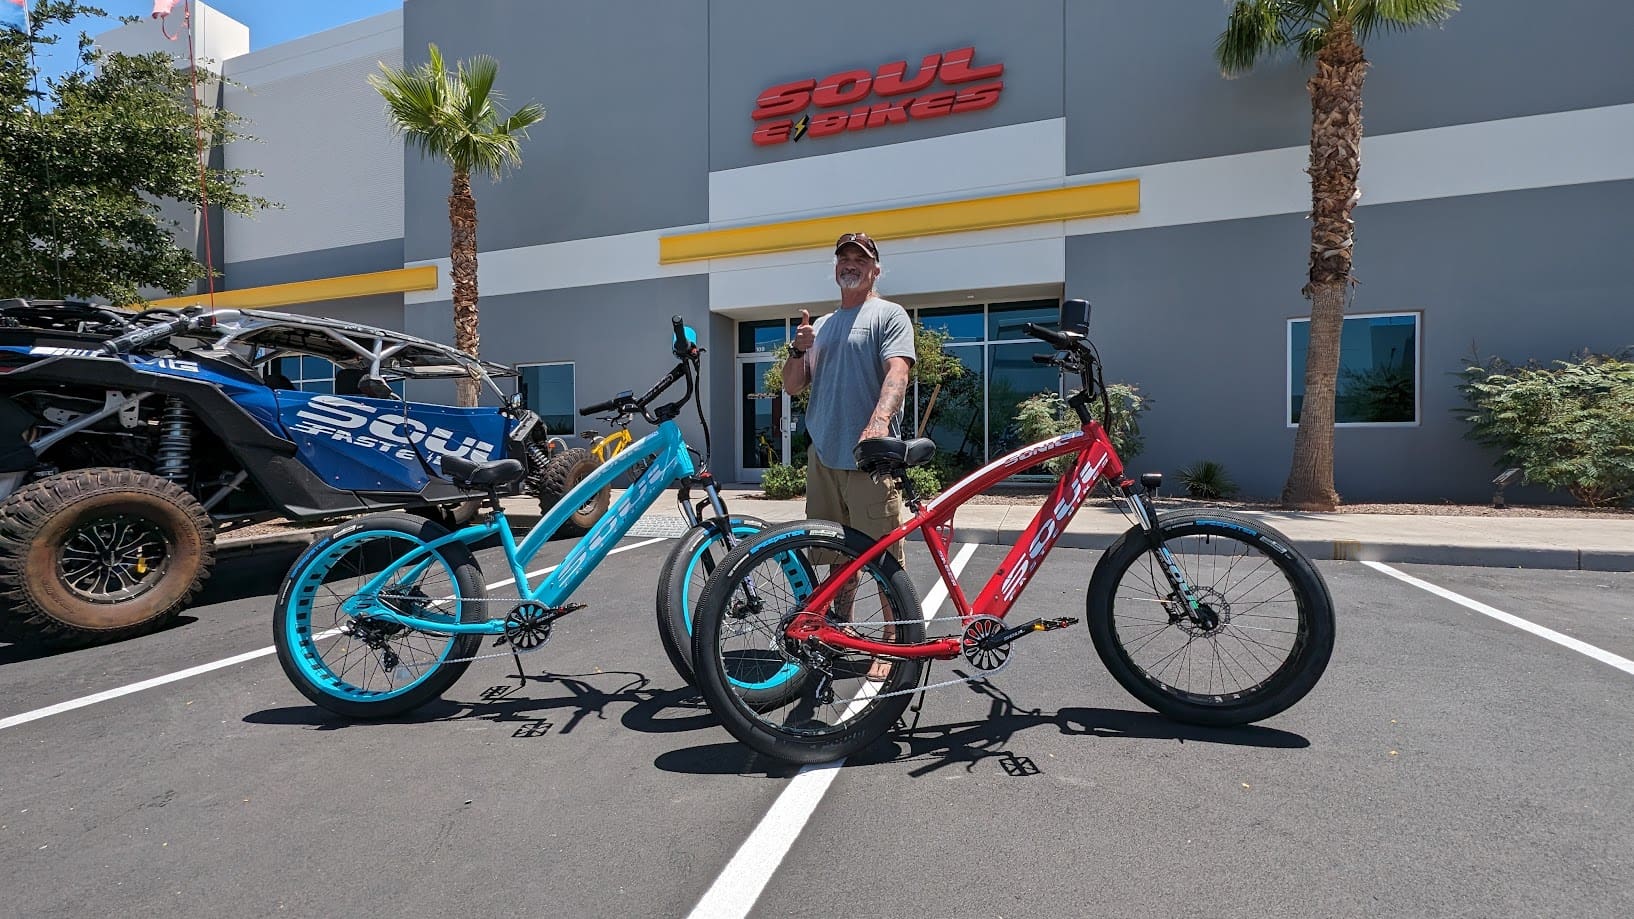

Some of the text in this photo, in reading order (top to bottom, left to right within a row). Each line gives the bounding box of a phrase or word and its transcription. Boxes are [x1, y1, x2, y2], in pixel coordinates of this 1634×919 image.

[752, 47, 1004, 121] SOUL
[1004, 438, 1070, 468] SONIC
[557, 457, 678, 588] SOUL
[1002, 452, 1108, 602] SOUL
